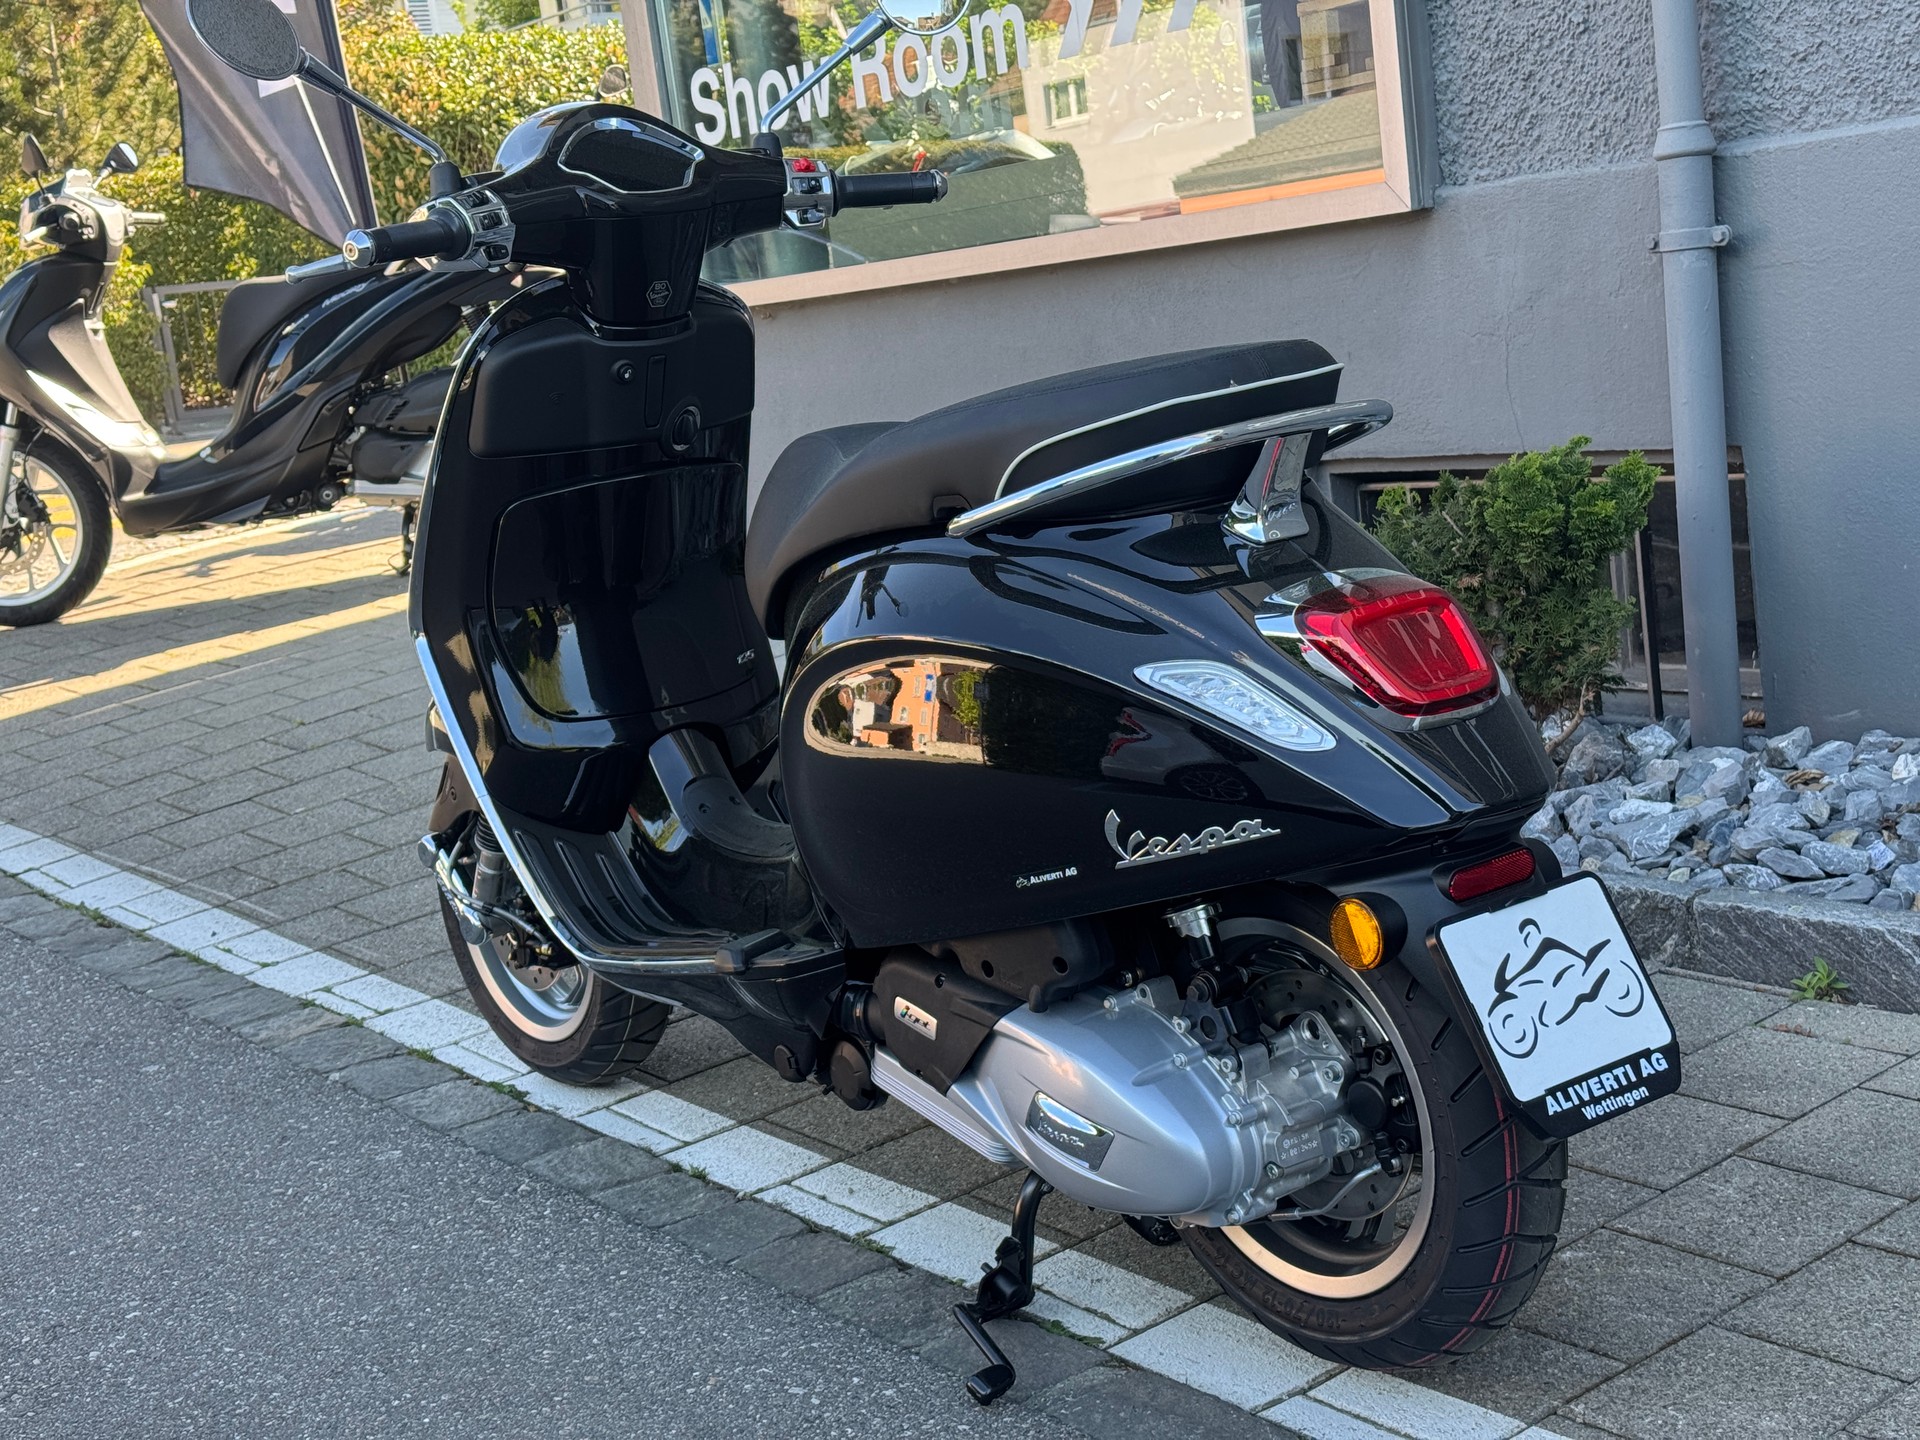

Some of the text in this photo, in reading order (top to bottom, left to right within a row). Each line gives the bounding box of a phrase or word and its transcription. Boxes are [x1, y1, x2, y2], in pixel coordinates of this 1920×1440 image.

[690, 4, 1030, 146] Show Room
[1104, 808, 1281, 869] Vespa
[1030, 866, 1078, 884] ALIVERTI AG
[1545, 1052, 1669, 1116] ALIVERTI AG
[1581, 1086, 1650, 1120] Wettingen
